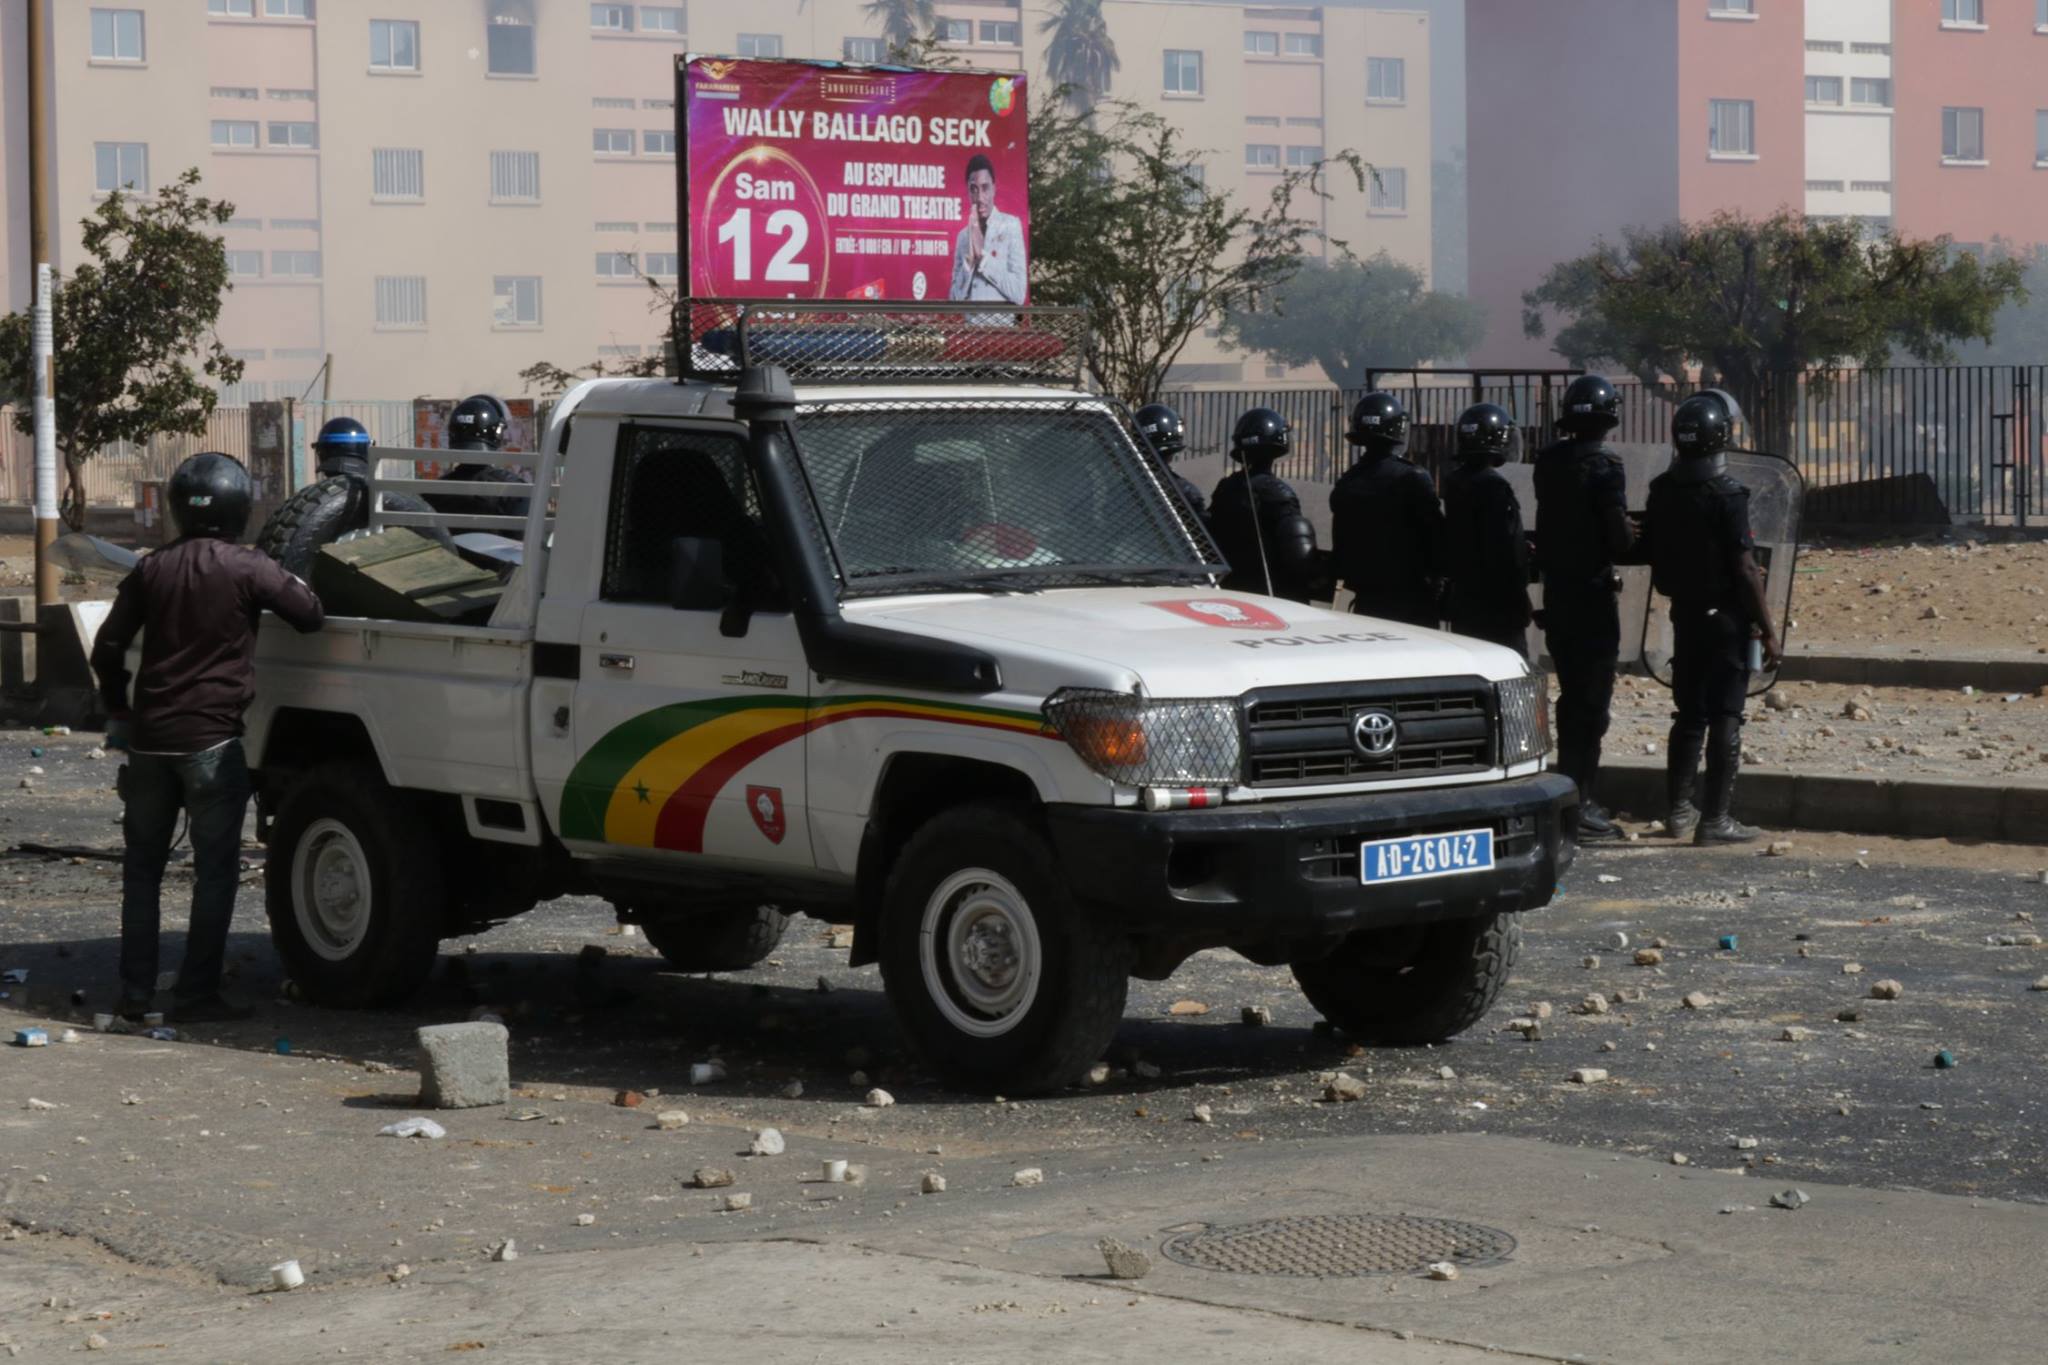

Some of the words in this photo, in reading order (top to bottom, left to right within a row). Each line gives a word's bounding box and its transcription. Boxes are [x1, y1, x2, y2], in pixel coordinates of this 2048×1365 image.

[828, 83, 889, 96] ANNIVERSAIRE
[723, 107, 805, 138] WALLY
[813, 111, 922, 144] BALLAGO
[929, 117, 992, 147] SECK
[735, 172, 795, 200] Sam
[844, 162, 864, 186] AU
[866, 162, 945, 189] ESPLANADE
[827, 193, 848, 217] DU
[851, 194, 900, 219] GRAND
[902, 195, 962, 221] THEATRE
[718, 208, 810, 283] 12
[1231, 631, 1408, 649] POLICE
[1377, 834, 1478, 877] AD-26042
